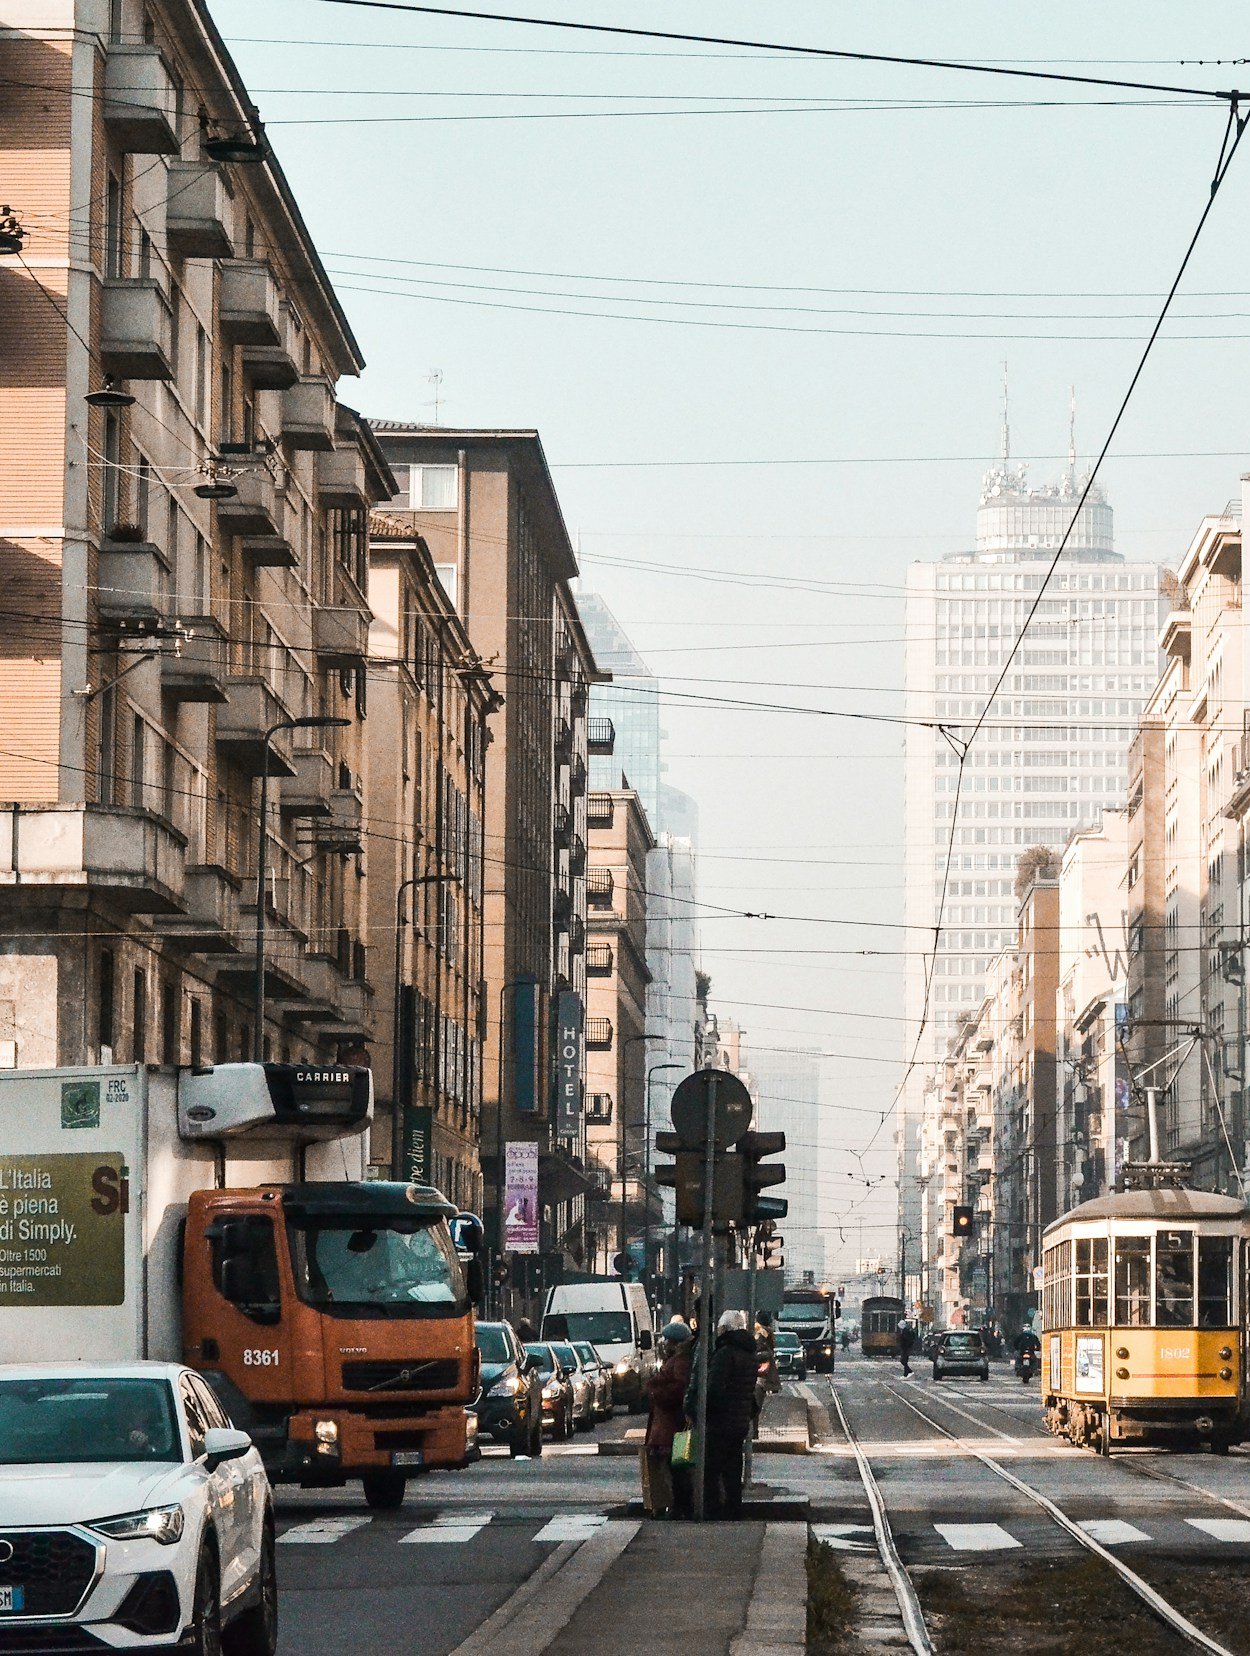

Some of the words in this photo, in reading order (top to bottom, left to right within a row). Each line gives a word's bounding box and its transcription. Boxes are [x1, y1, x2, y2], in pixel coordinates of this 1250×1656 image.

[296, 1071, 350, 1082] CARRIER
[563, 1026, 576, 1116] HOTEL
[108, 1080, 126, 1093] FRC
[407, 1129, 425, 1163] diem
[0, 1168, 52, 1190] L'Italia
[0, 1194, 9, 1214] è
[13, 1194, 58, 1219] piena
[0, 1220, 13, 1240] di
[19, 1219, 77, 1245] Simply.
[1168, 1231, 1181, 1248] 5
[0, 1249, 21, 1261] Oltre
[24, 1249, 47, 1261] 1500
[0, 1264, 61, 1279] supermercati
[10, 1280, 35, 1292] Italia.
[243, 1349, 279, 1366] 8361
[1160, 1347, 1191, 1359] 1802
